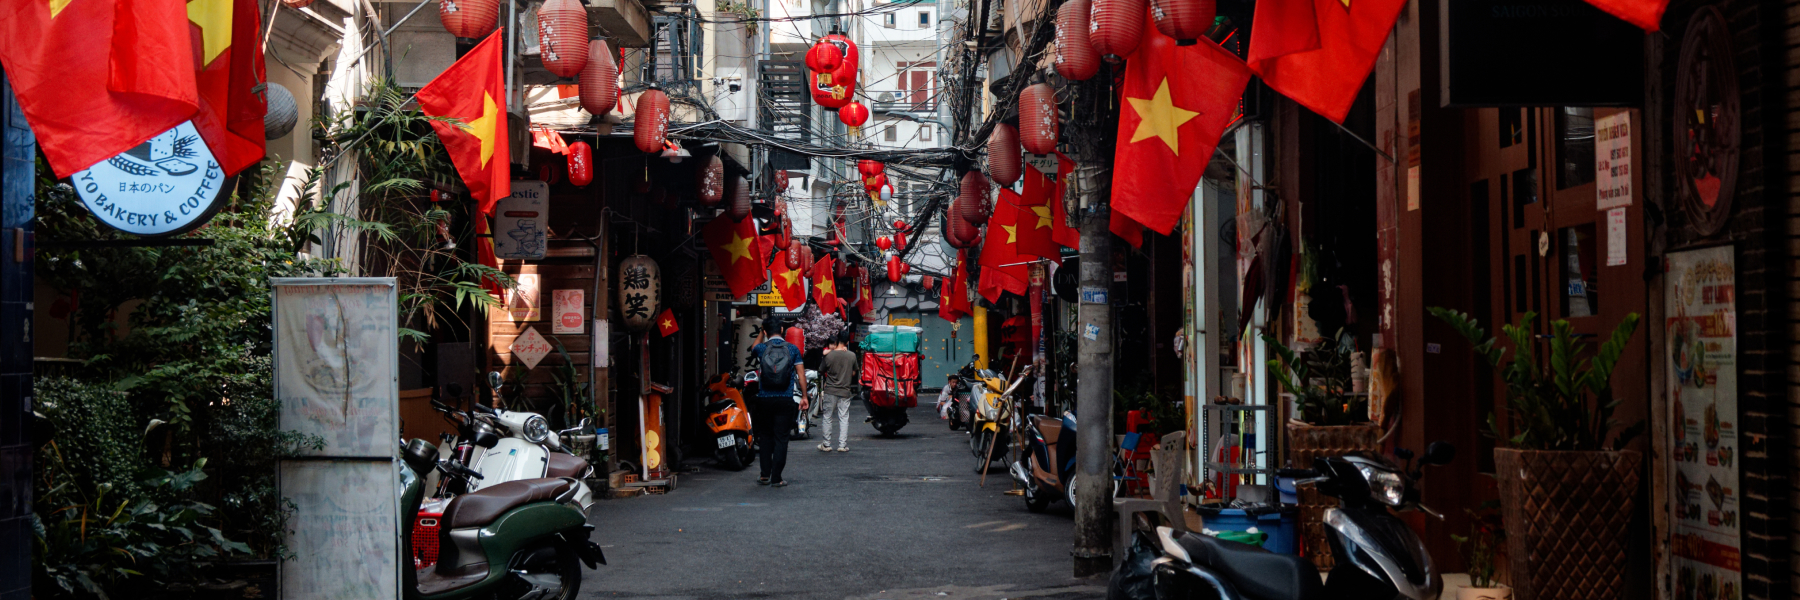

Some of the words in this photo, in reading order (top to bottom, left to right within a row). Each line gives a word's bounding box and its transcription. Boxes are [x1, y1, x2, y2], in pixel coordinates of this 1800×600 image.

[1491, 5, 1547, 18] SAIGON
[80, 170, 99, 194] YO
[94, 193, 159, 227] BAKERY
[164, 210, 178, 224] &
[179, 160, 220, 216] COFFEE
[119, 181, 176, 194] 日本のパン
[510, 188, 539, 199] estic
[513, 343, 550, 353] キンチョール
